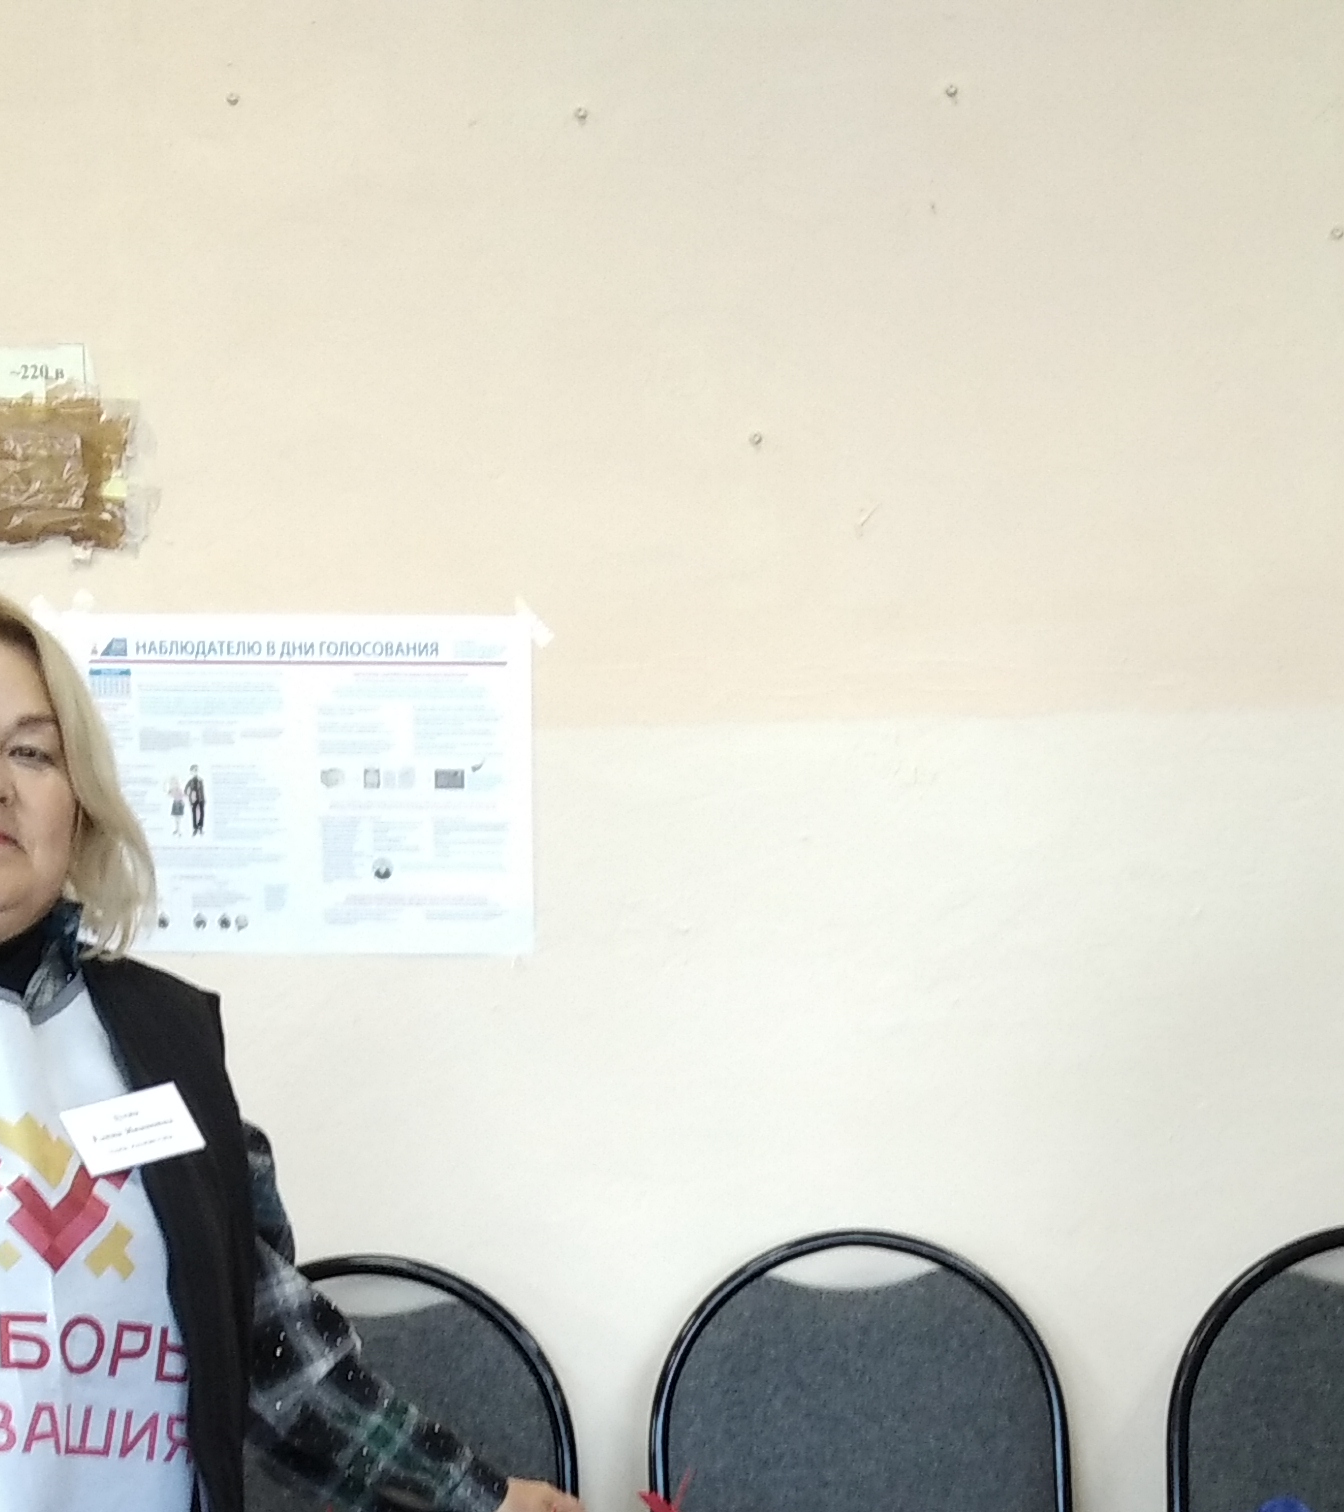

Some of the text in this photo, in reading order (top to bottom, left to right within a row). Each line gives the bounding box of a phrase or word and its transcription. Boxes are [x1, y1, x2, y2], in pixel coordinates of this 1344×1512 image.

[135, 639, 263, 660] НАБЛЮДАТЕЛЮ
[266, 641, 277, 657] В
[280, 641, 316, 660] ДНИ
[318, 640, 441, 659] ГОЛОСОВАНИЯ
